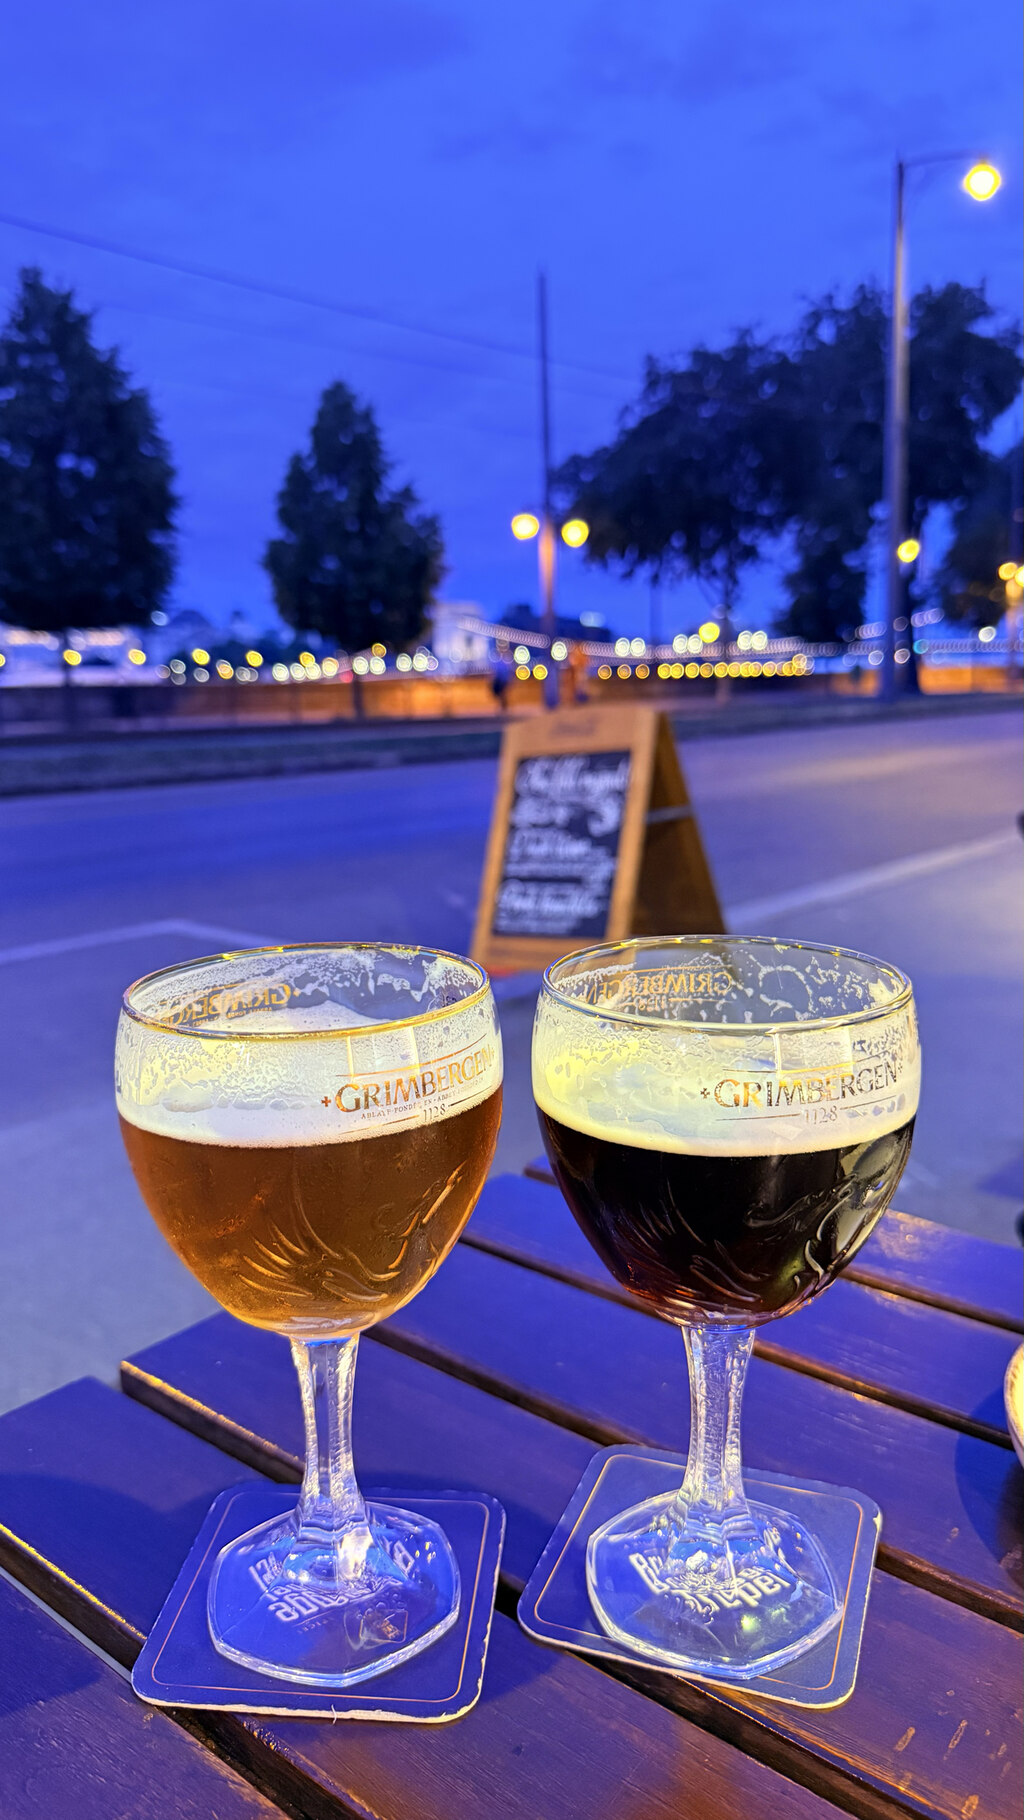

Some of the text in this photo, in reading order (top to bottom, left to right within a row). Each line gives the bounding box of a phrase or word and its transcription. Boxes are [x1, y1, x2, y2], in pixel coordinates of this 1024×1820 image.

[335, 1043, 493, 1113] GRIMBERGEN
[714, 1060, 898, 1108] GRIMBERGEN
[424, 1103, 446, 1122] 1128
[804, 1105, 838, 1125] 1128
